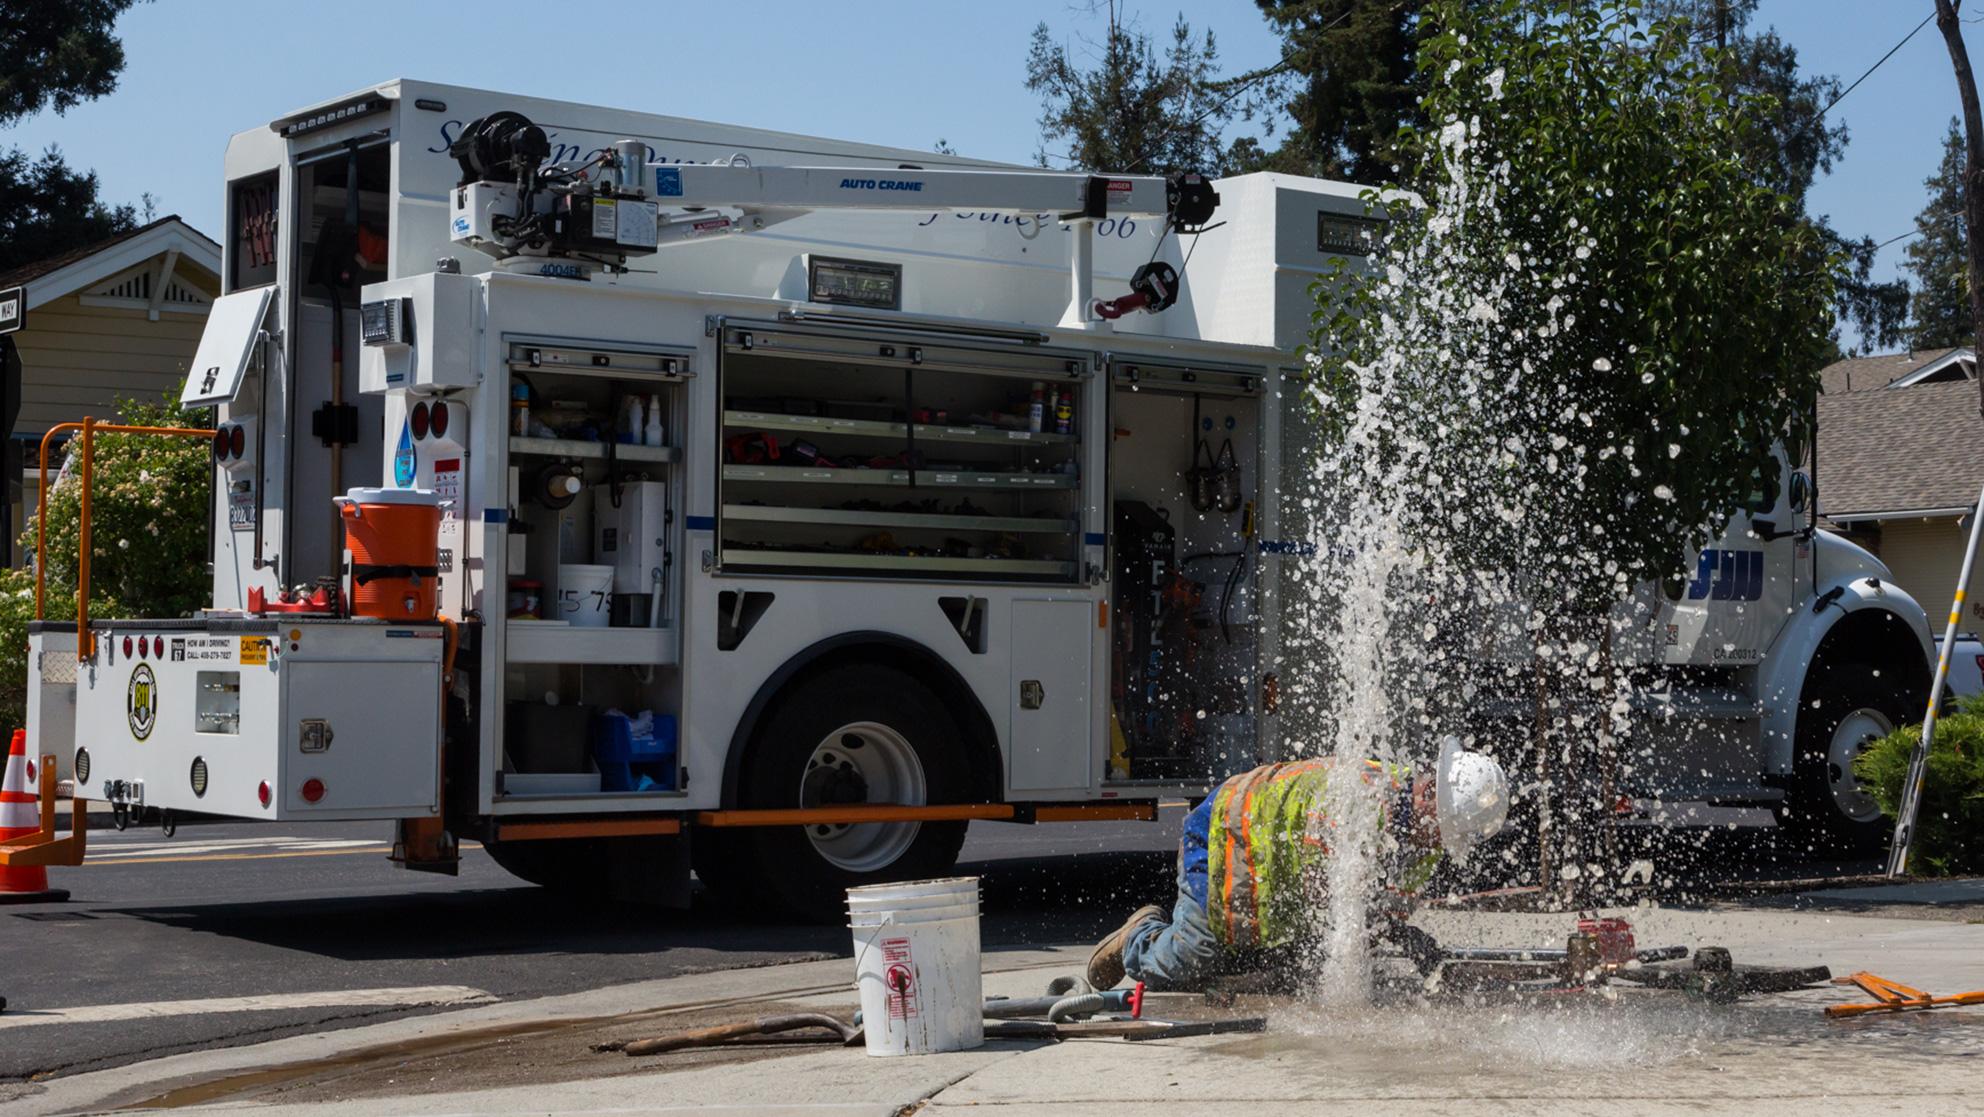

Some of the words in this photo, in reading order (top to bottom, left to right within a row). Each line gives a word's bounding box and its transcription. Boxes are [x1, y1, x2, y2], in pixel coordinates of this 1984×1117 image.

[840, 179, 876, 190] AUTO
[878, 180, 923, 191] CRANE
[1107, 182, 1130, 190] ANGER
[1, 301, 15, 319] WAY
[187, 639, 197, 647] HOW
[199, 639, 206, 647] AM
[135, 682, 150, 708] 811
